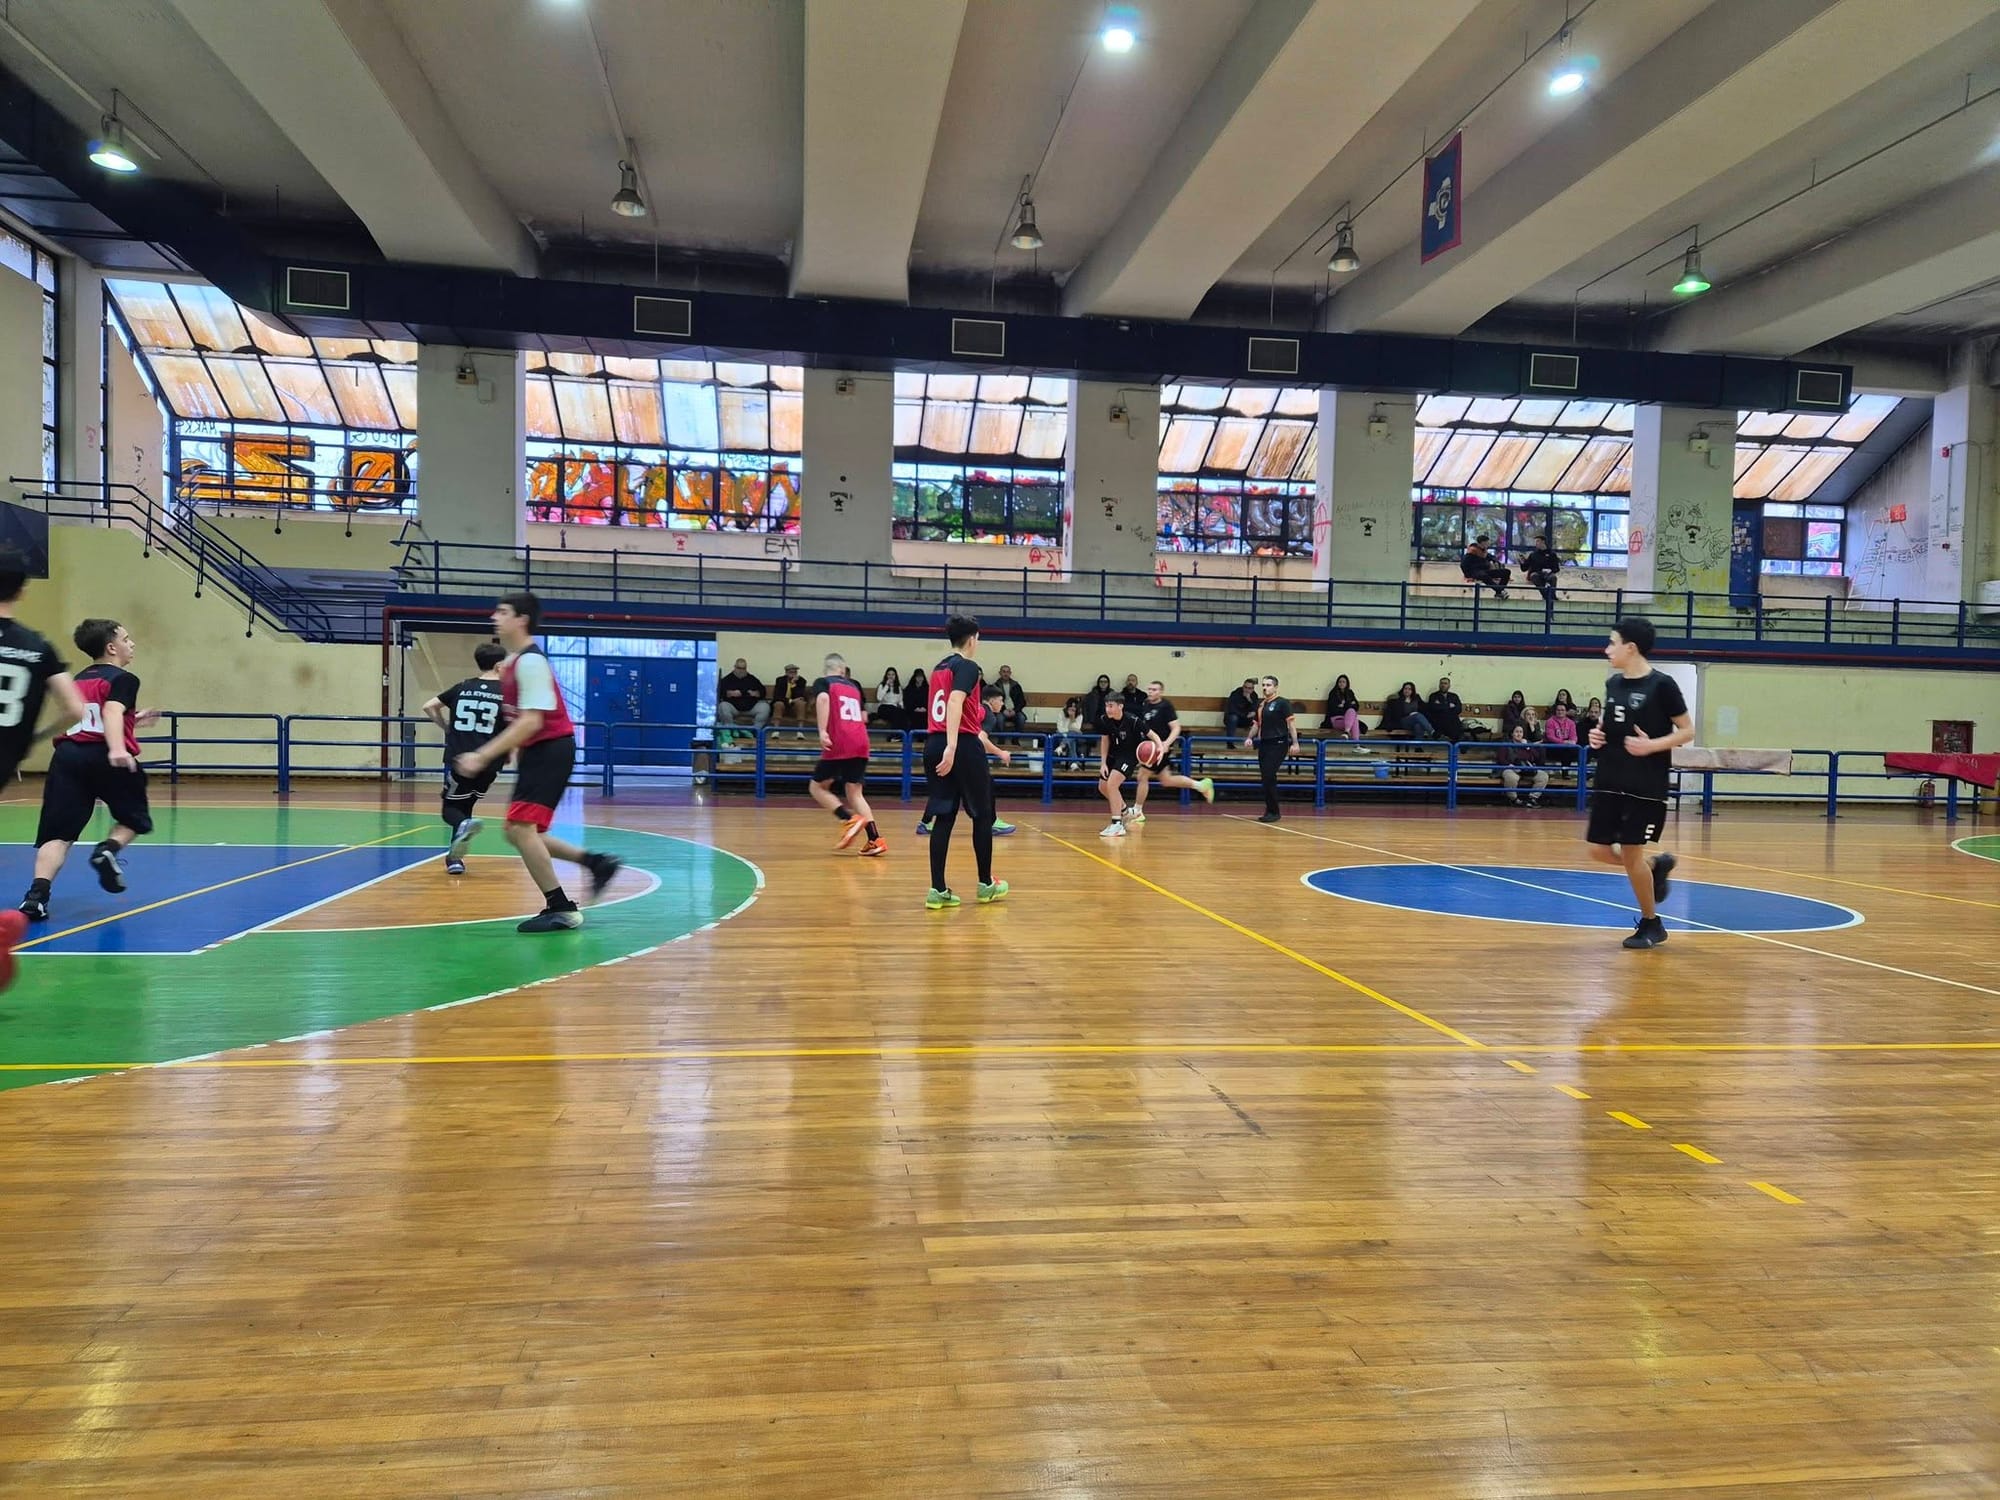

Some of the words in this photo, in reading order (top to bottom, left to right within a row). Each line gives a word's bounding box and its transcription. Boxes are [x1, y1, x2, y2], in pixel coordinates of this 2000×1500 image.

[454, 698, 499, 735] 53
[839, 695, 862, 722] 20
[931, 688, 947, 723] 6
[1613, 705, 1626, 723] 5
